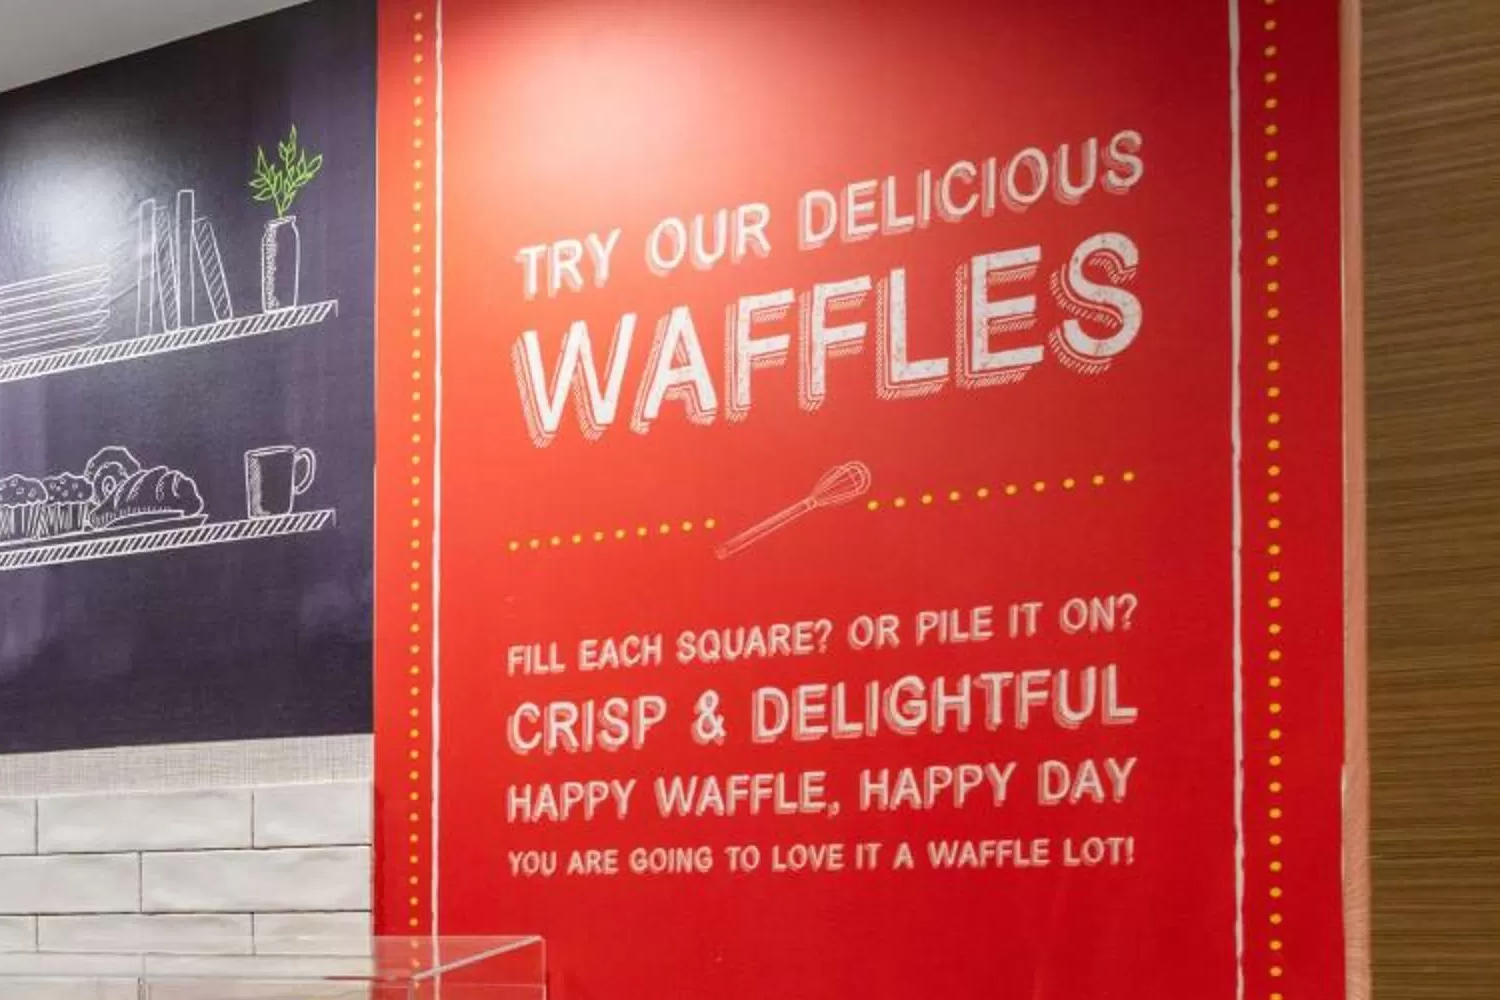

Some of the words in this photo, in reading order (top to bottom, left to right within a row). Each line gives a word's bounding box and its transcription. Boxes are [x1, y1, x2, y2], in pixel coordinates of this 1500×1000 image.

[515, 229, 621, 300] TRY
[645, 202, 771, 277] OUR
[799, 129, 1144, 251] DELICIOUS
[511, 232, 1143, 449] WAFFLES
[507, 642, 565, 676] FILL
[578, 633, 663, 672] EACH
[676, 619, 833, 664] SQUARE?
[848, 614, 900, 649] OR
[916, 605, 993, 646] PILE
[1009, 602, 1043, 640] IT
[1060, 593, 1138, 634] ON?
[507, 695, 667, 756] CRISP
[692, 689, 727, 747] &
[752, 664, 1139, 744] DELIGHTFUL
[507, 778, 636, 823] HAPPY
[654, 770, 840, 818] WAFFLE,
[859, 761, 1017, 811] HAPPY
[1038, 757, 1137, 805] DAY
[508, 850, 557, 877] YOU
[567, 848, 620, 875] ARE
[628, 846, 713, 874] GOING
[725, 844, 760, 872] TO
[771, 843, 845, 873] LOVE
[855, 842, 882, 871] IT
[893, 842, 914, 871] A
[927, 838, 1051, 869] WAFFLE
[1063, 836, 1135, 866] LOT!
